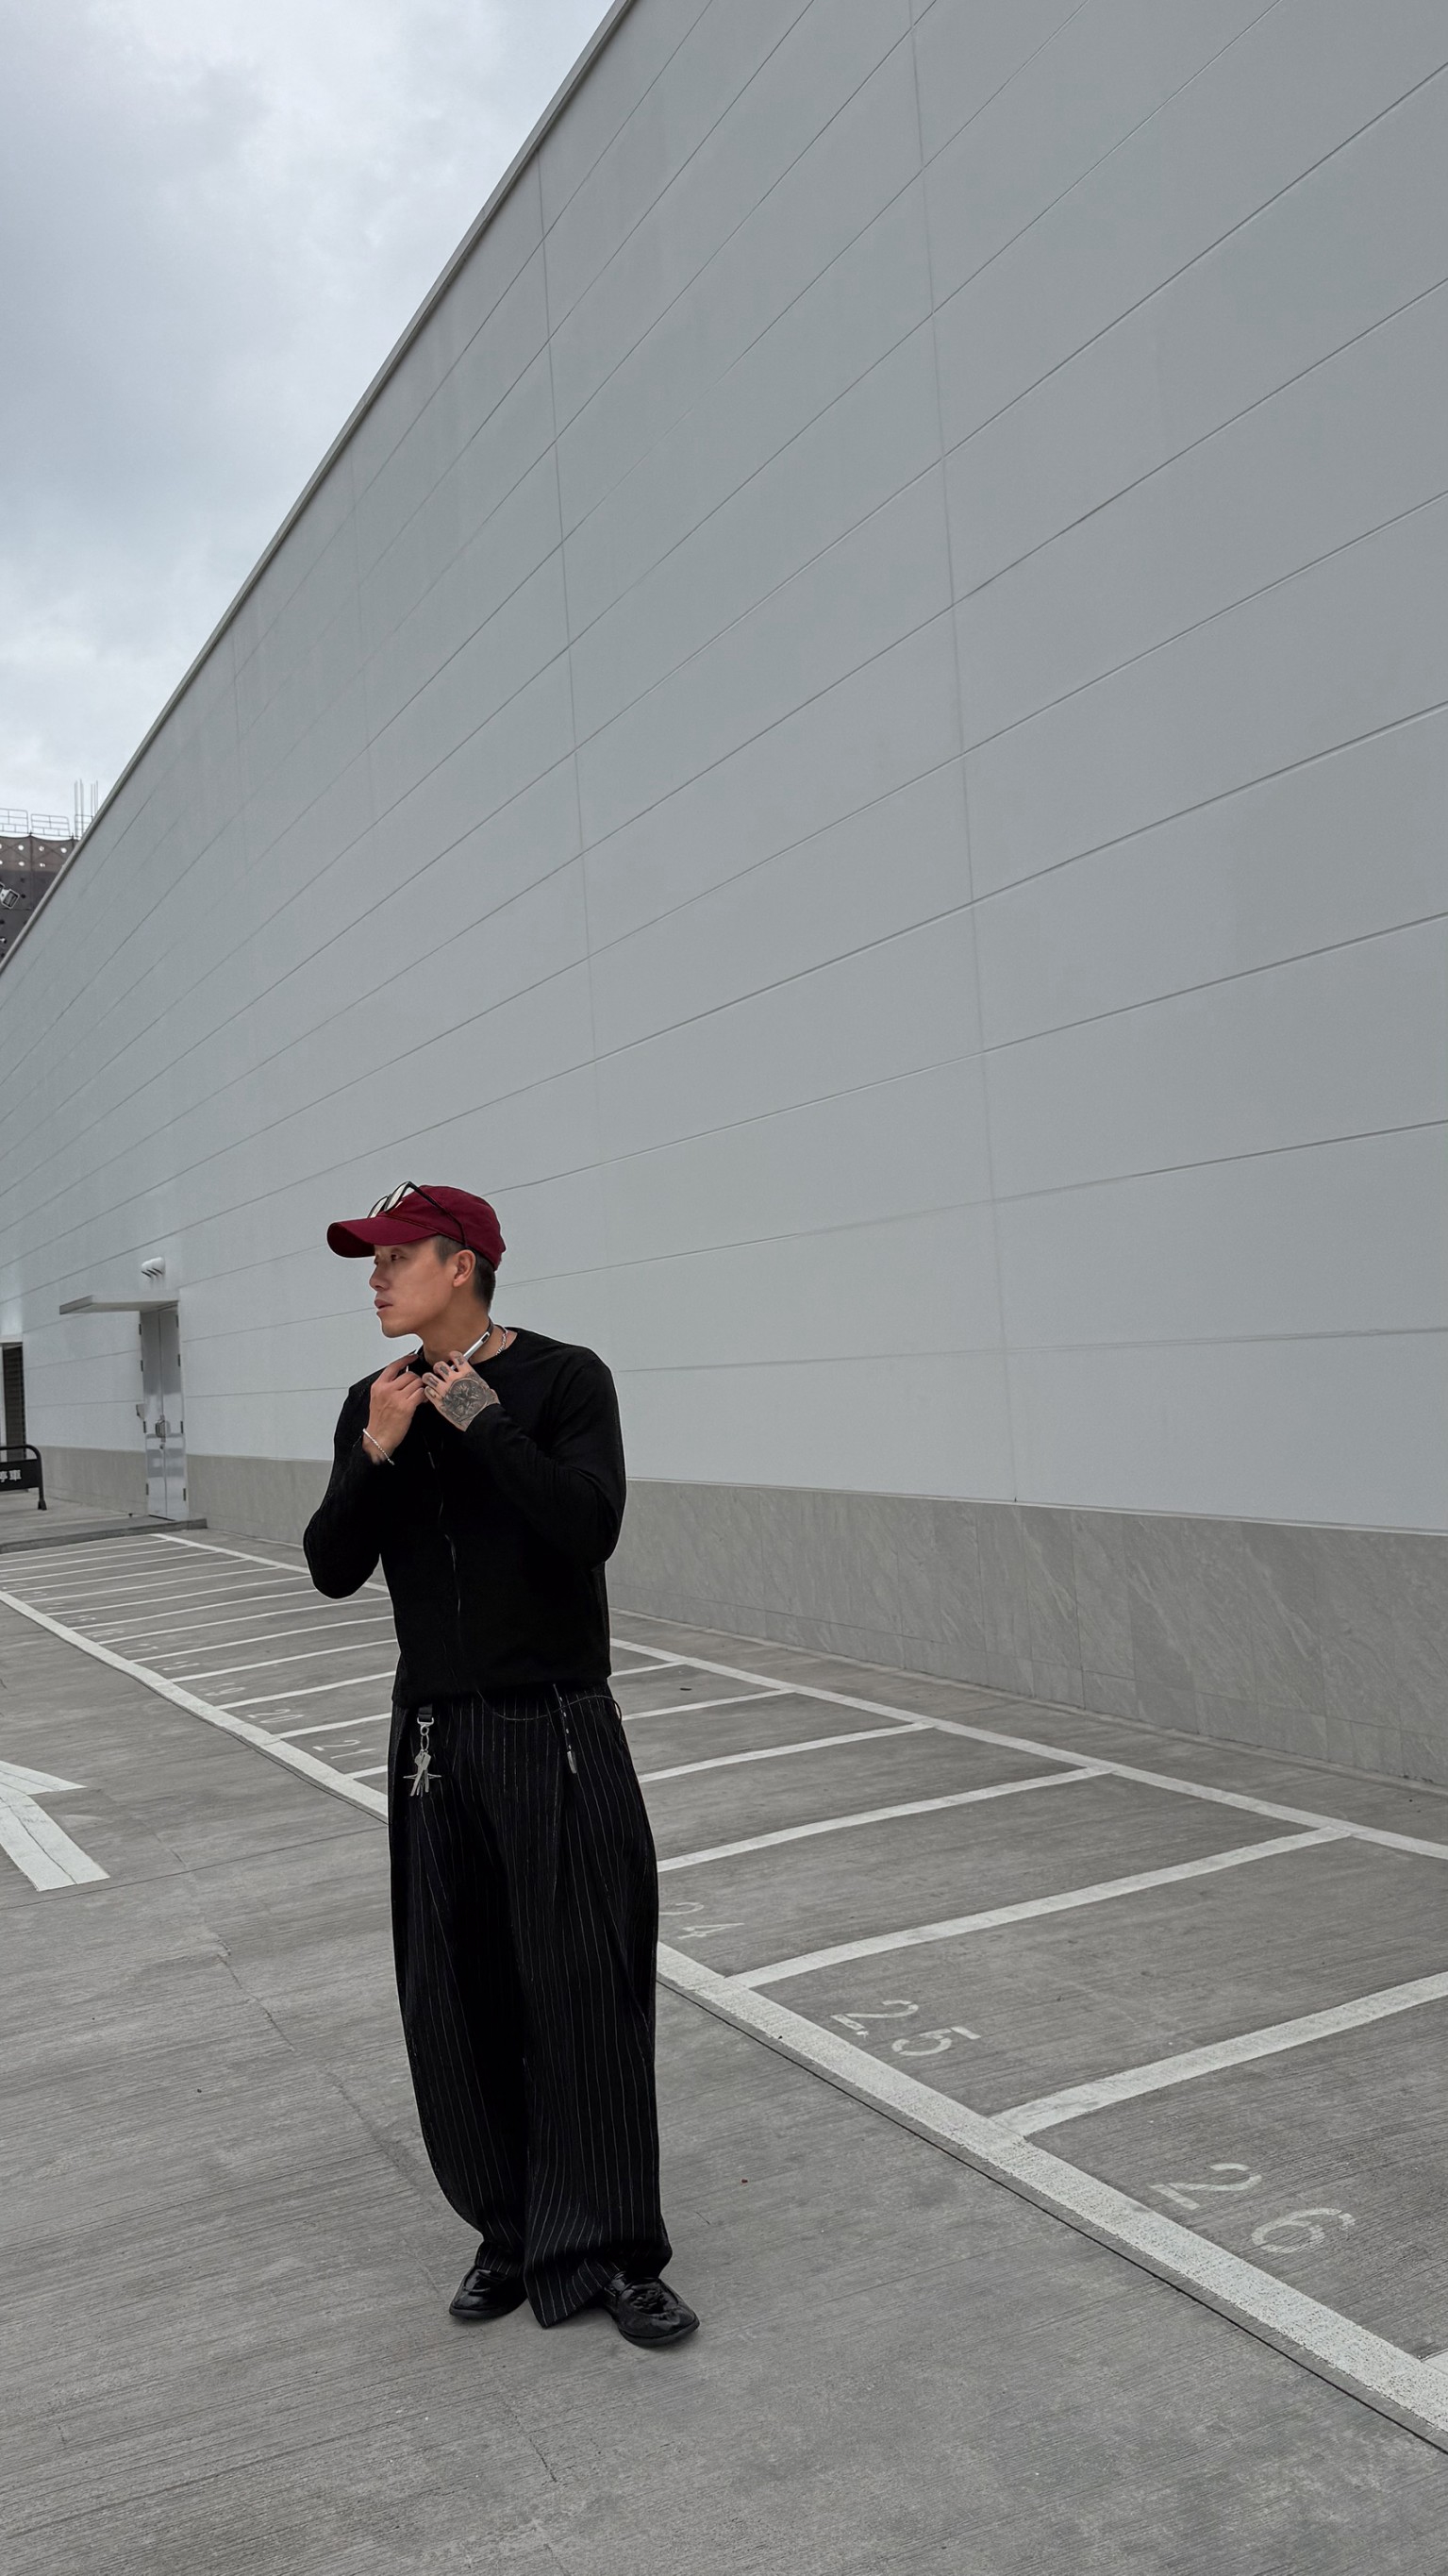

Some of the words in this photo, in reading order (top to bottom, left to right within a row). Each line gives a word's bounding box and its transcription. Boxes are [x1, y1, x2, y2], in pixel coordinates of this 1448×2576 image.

[247, 1708, 305, 1724] 20
[312, 1739, 376, 1760] 21
[658, 1901, 745, 1940] 24
[830, 1999, 982, 2056] 25
[1149, 2163, 1356, 2253] 26
